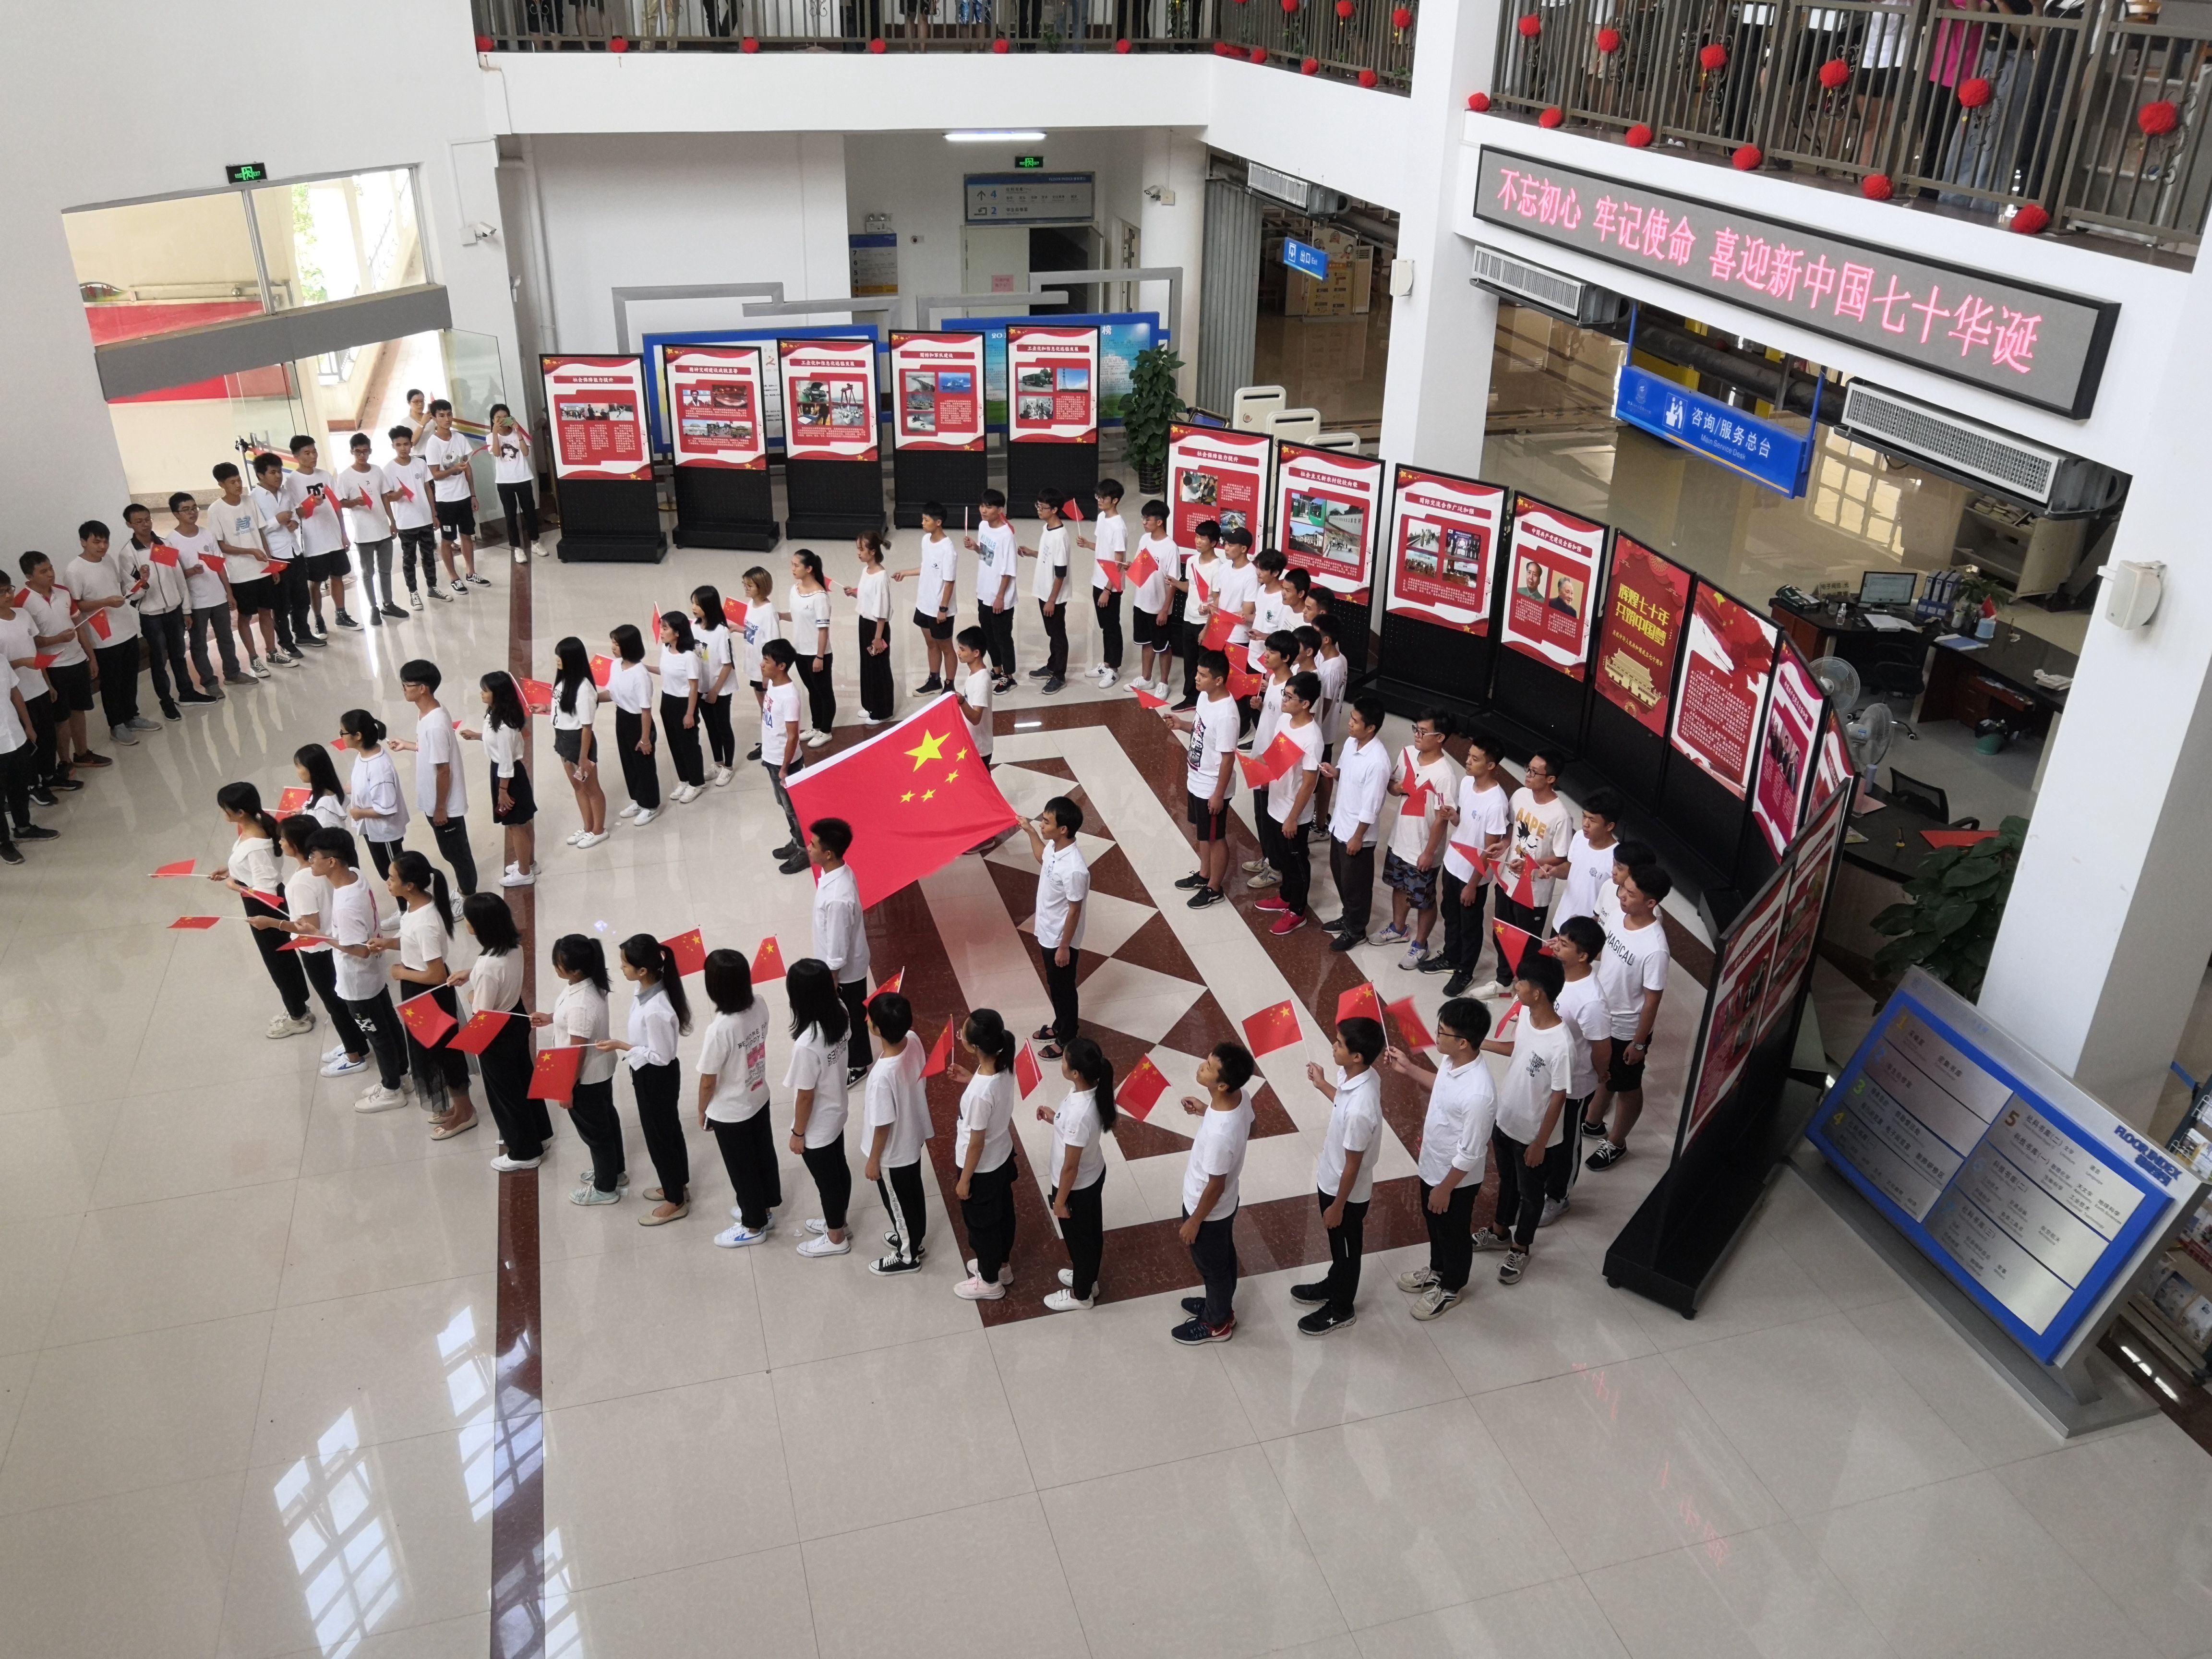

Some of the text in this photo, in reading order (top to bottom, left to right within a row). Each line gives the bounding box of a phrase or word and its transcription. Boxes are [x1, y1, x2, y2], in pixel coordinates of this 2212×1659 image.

[990, 190, 997, 198] 4
[991, 206, 997, 215] 2
[1300, 249, 1310, 265] 出口
[1497, 168, 2043, 373] 不忘初心 牢记使命 喜迎新中国七十华诞
[1102, 325, 1112, 336] 榜
[1692, 407, 1771, 458] 咨询/服务总台
[1197, 451, 1238, 463] 社会保障能力提升
[1701, 433, 1747, 460] Main Service Desk
[1300, 470, 1358, 488] 社会主义新农村欣欣向荣
[1419, 497, 1475, 515] 国际交流合作广泛加强
[1531, 527, 1582, 553] 中国共产党建设全面加强
[1618, 583, 1671, 626] 辉煌七十年
[1615, 601, 1667, 648] 共筑中国梦
[1612, 628, 1664, 668] 庆祝中华人民共和国成立七十周年
[1515, 807, 1547, 839] AAPE
[1606, 930, 1634, 966] MAGICAL
[1895, 1013, 1910, 1031] 1
[1851, 1077, 1867, 1096] 3
[1830, 1108, 1846, 1128] 4
[2004, 1109, 2021, 1129] 5
[2024, 1114, 2064, 1148] 社科书库(二)
[2063, 1144, 2075, 1156] 文学
[2114, 1125, 2183, 1181] FLOOR INDEX
[1992, 1160, 2029, 1194] 科技书库(二)
[2012, 1131, 2052, 1166] 科技书库(一)
[2076, 1182, 2093, 1198] 天文学
[2097, 1197, 2121, 1218] 地球科学
[2068, 1192, 2091, 1213] 工业技术
